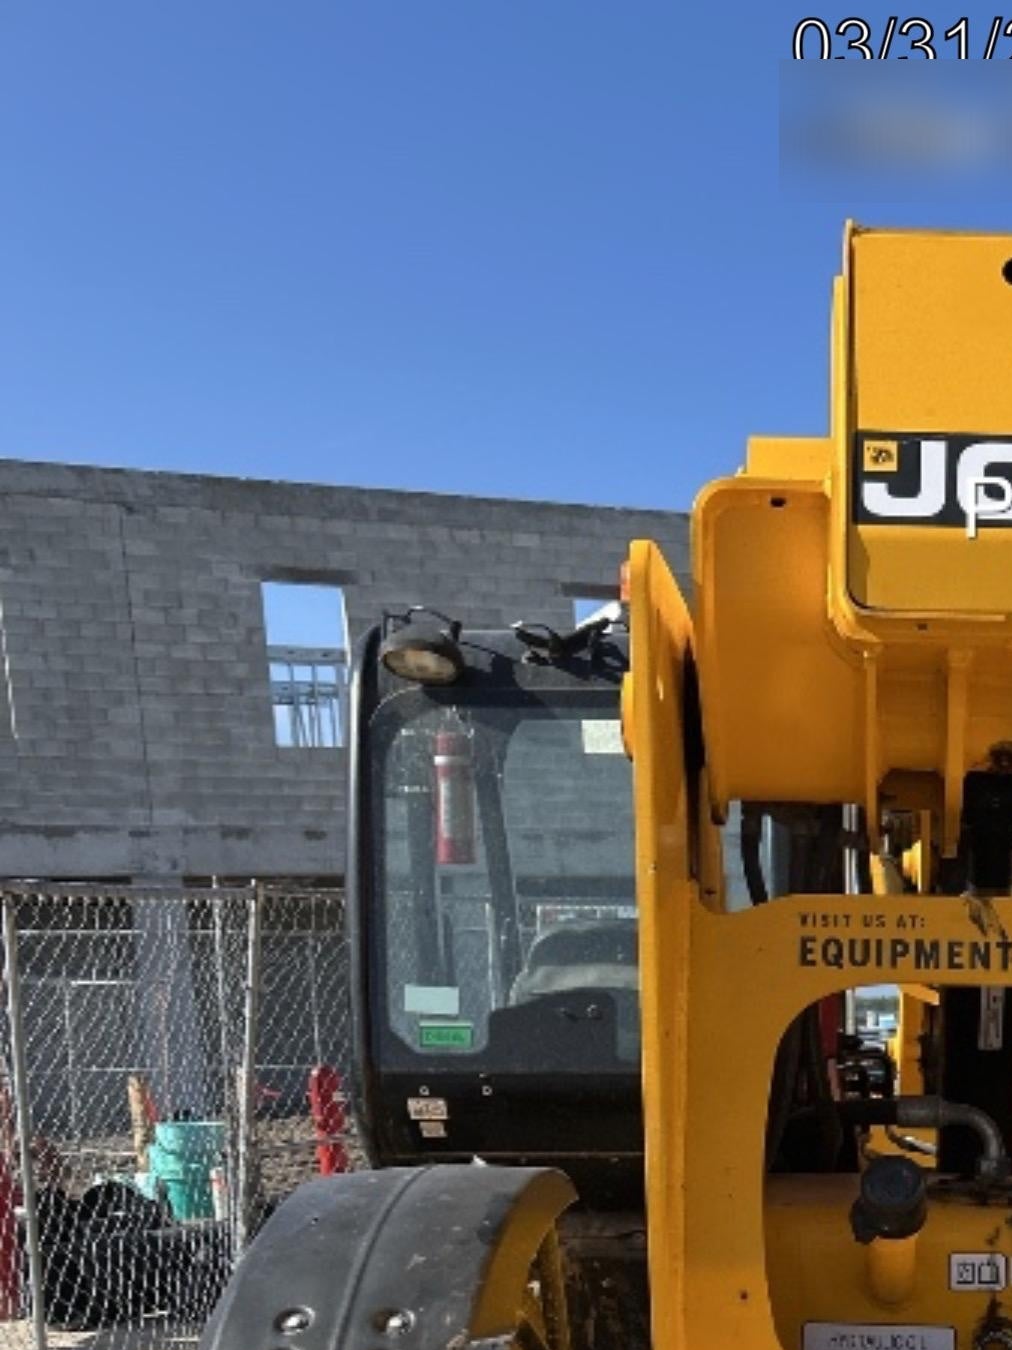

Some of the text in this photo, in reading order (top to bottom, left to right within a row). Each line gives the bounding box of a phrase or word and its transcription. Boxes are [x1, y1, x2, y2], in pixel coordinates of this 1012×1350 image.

[799, 911, 926, 930] VISIT US AT:
